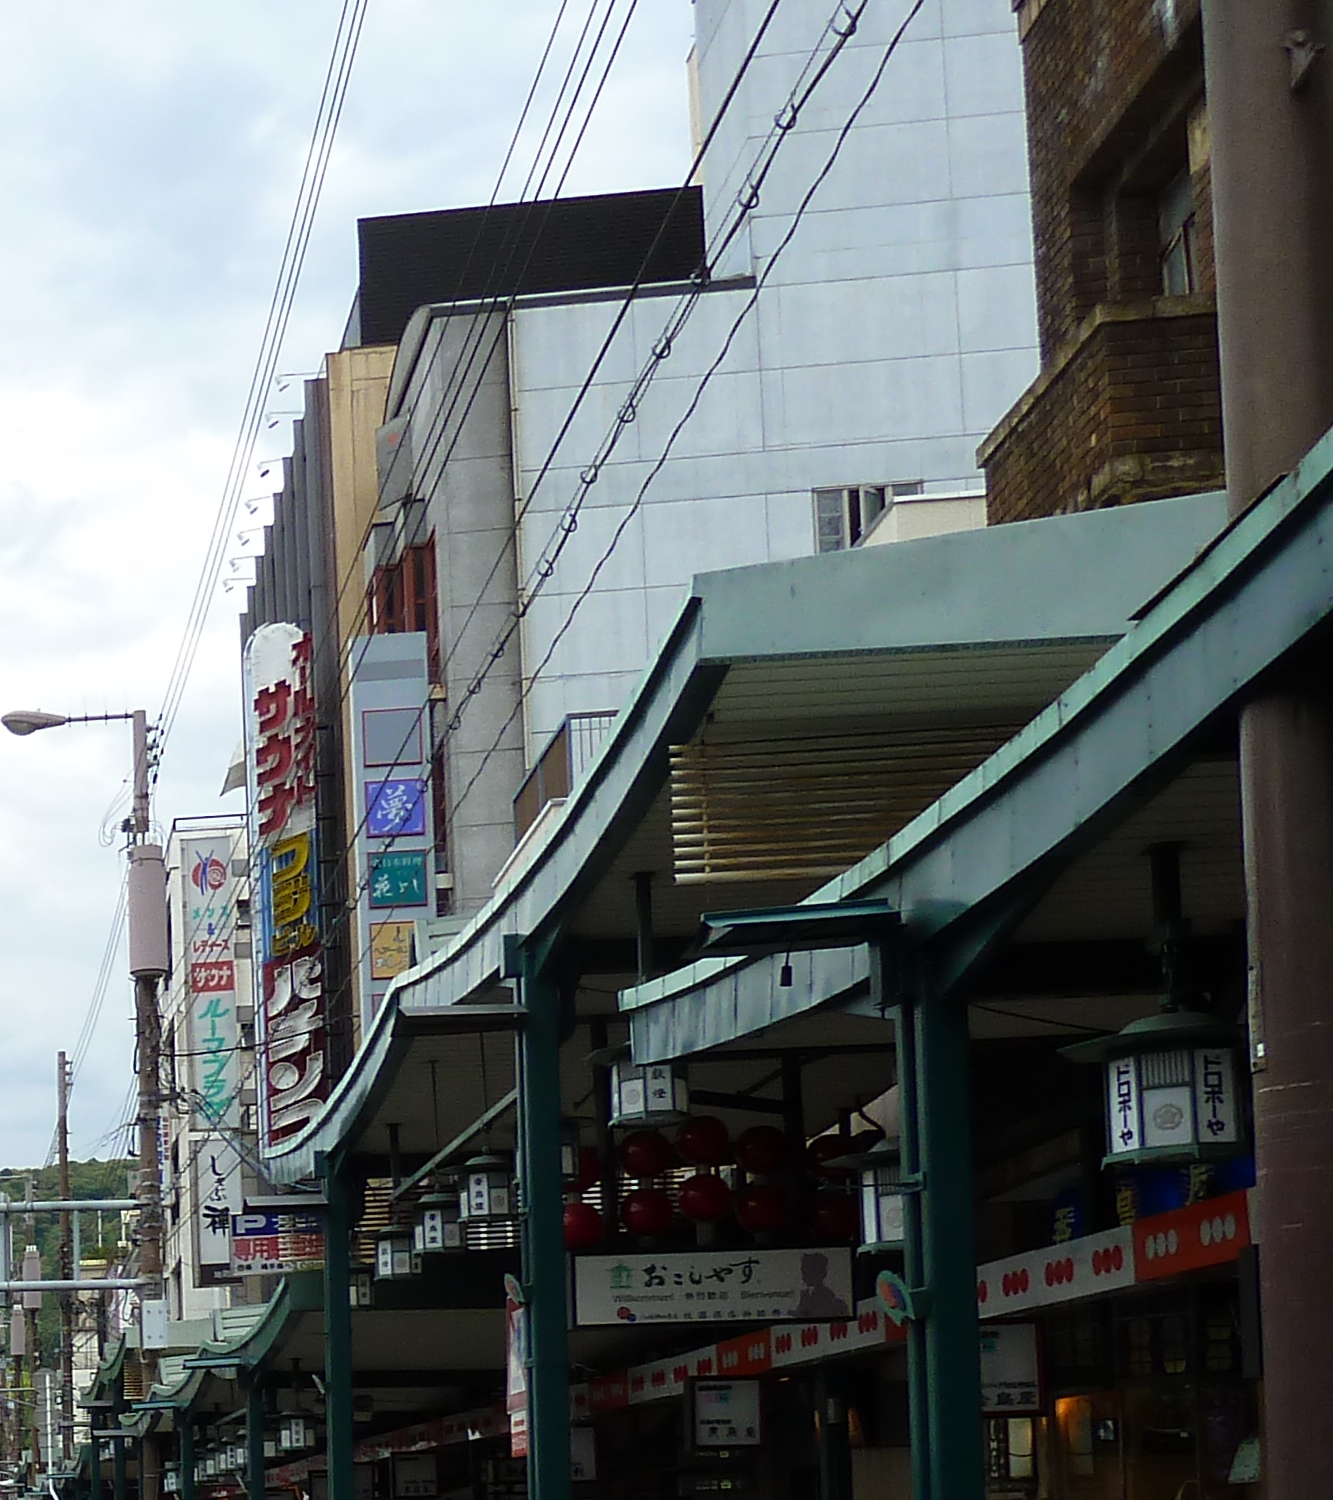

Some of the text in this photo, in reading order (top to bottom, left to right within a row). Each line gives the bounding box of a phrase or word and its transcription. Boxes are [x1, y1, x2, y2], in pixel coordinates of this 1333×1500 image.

[253, 679, 295, 836] サウナ
[376, 785, 412, 833] 夢
[193, 938, 230, 952] レディース
[194, 965, 232, 988] サウナ
[236, 1215, 267, 1234] P
